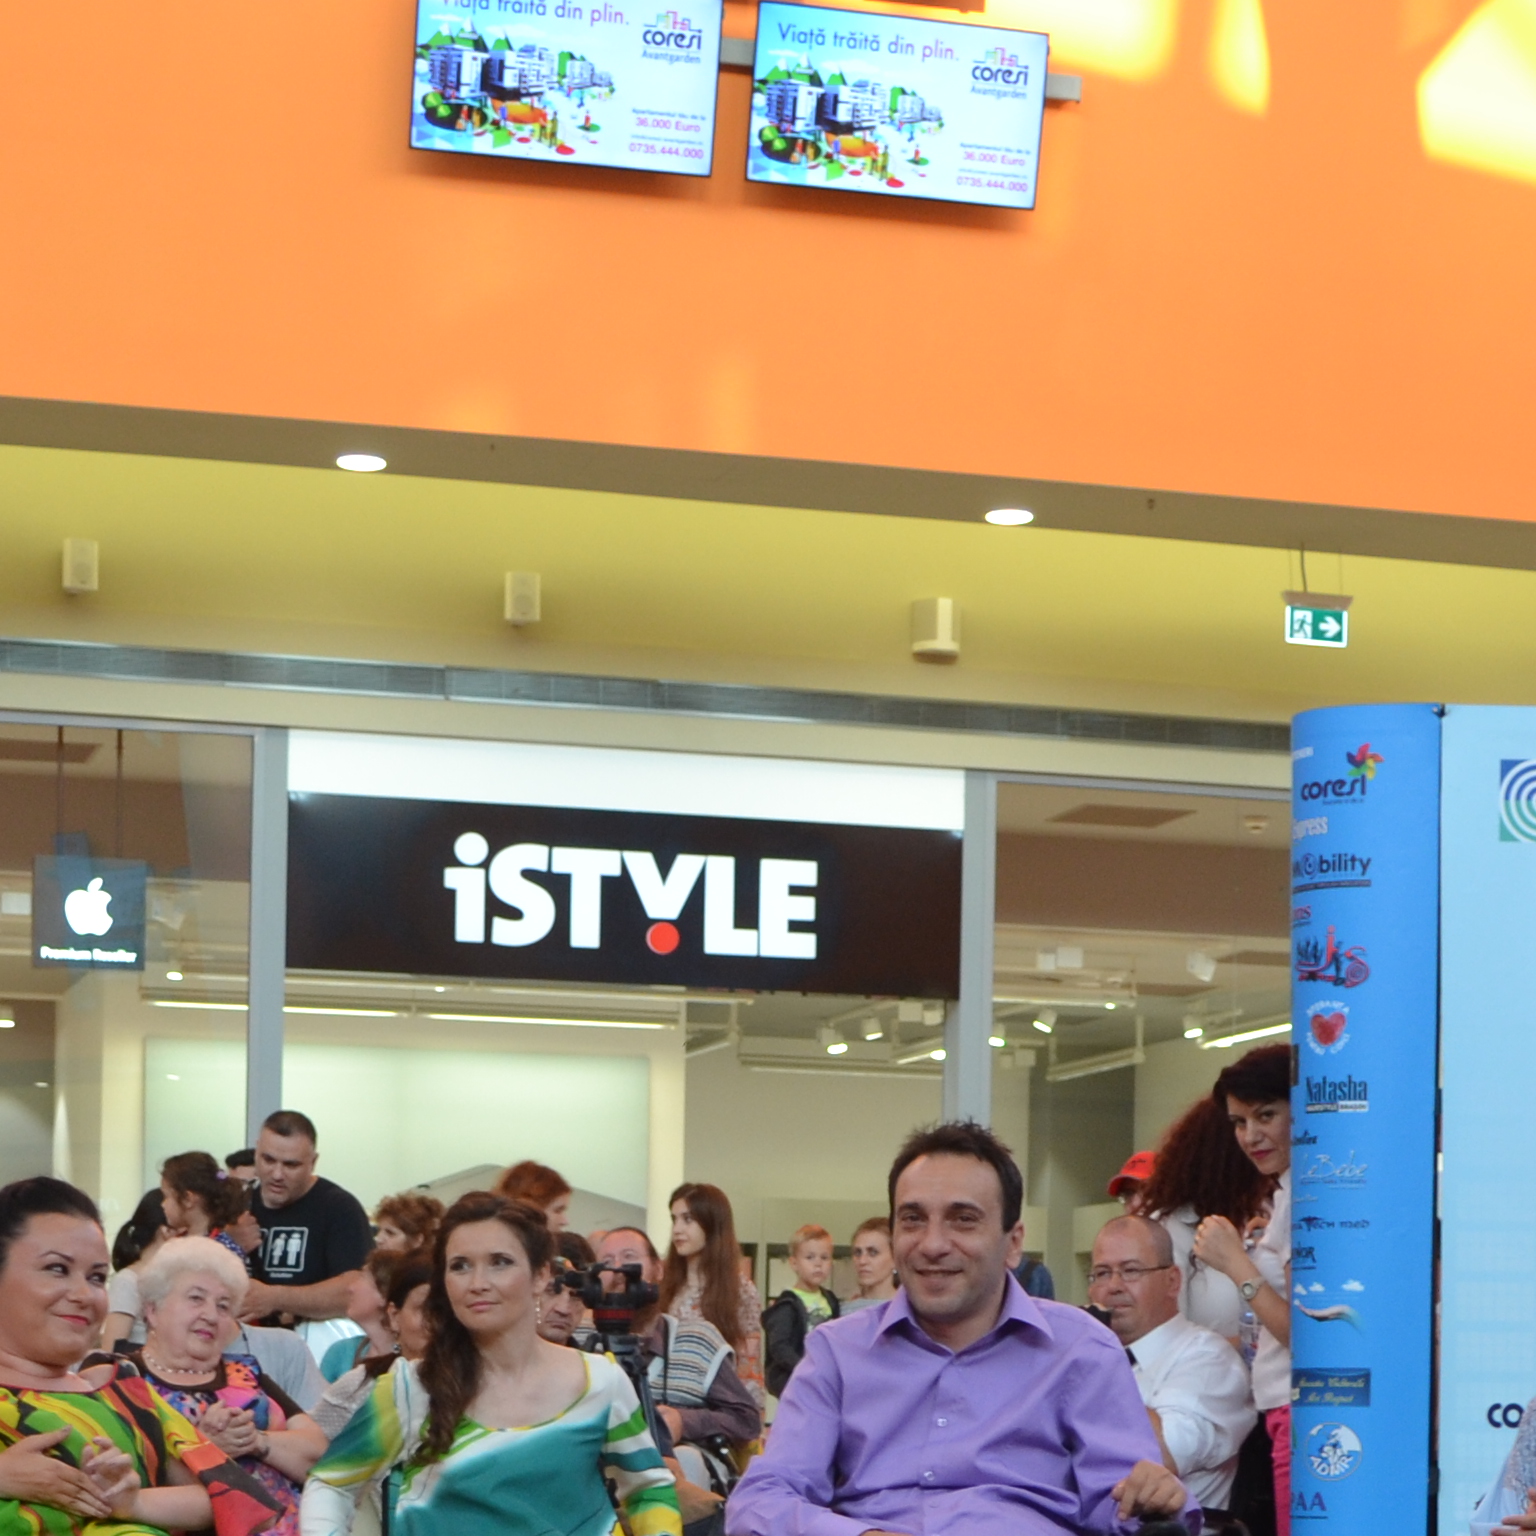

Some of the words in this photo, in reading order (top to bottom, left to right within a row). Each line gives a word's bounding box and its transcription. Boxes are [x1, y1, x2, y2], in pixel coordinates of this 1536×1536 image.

[554, 0, 583, 20] din
[590, 2, 630, 27] plin.
[642, 29, 703, 51] coresi
[777, 22, 826, 50] Viață
[833, 28, 881, 51] trăită
[888, 34, 915, 56] din
[921, 38, 960, 62] plin.
[640, 50, 702, 66] Avantgarden
[971, 64, 1029, 86] coresi
[970, 84, 1028, 100] Avantgarden
[674, 120, 702, 133] Euro
[1000, 154, 1027, 167] Euro
[1300, 773, 1367, 801] coresi
[443, 831, 819, 960] iSTYLE
[1305, 1073, 1368, 1103] Natasha
